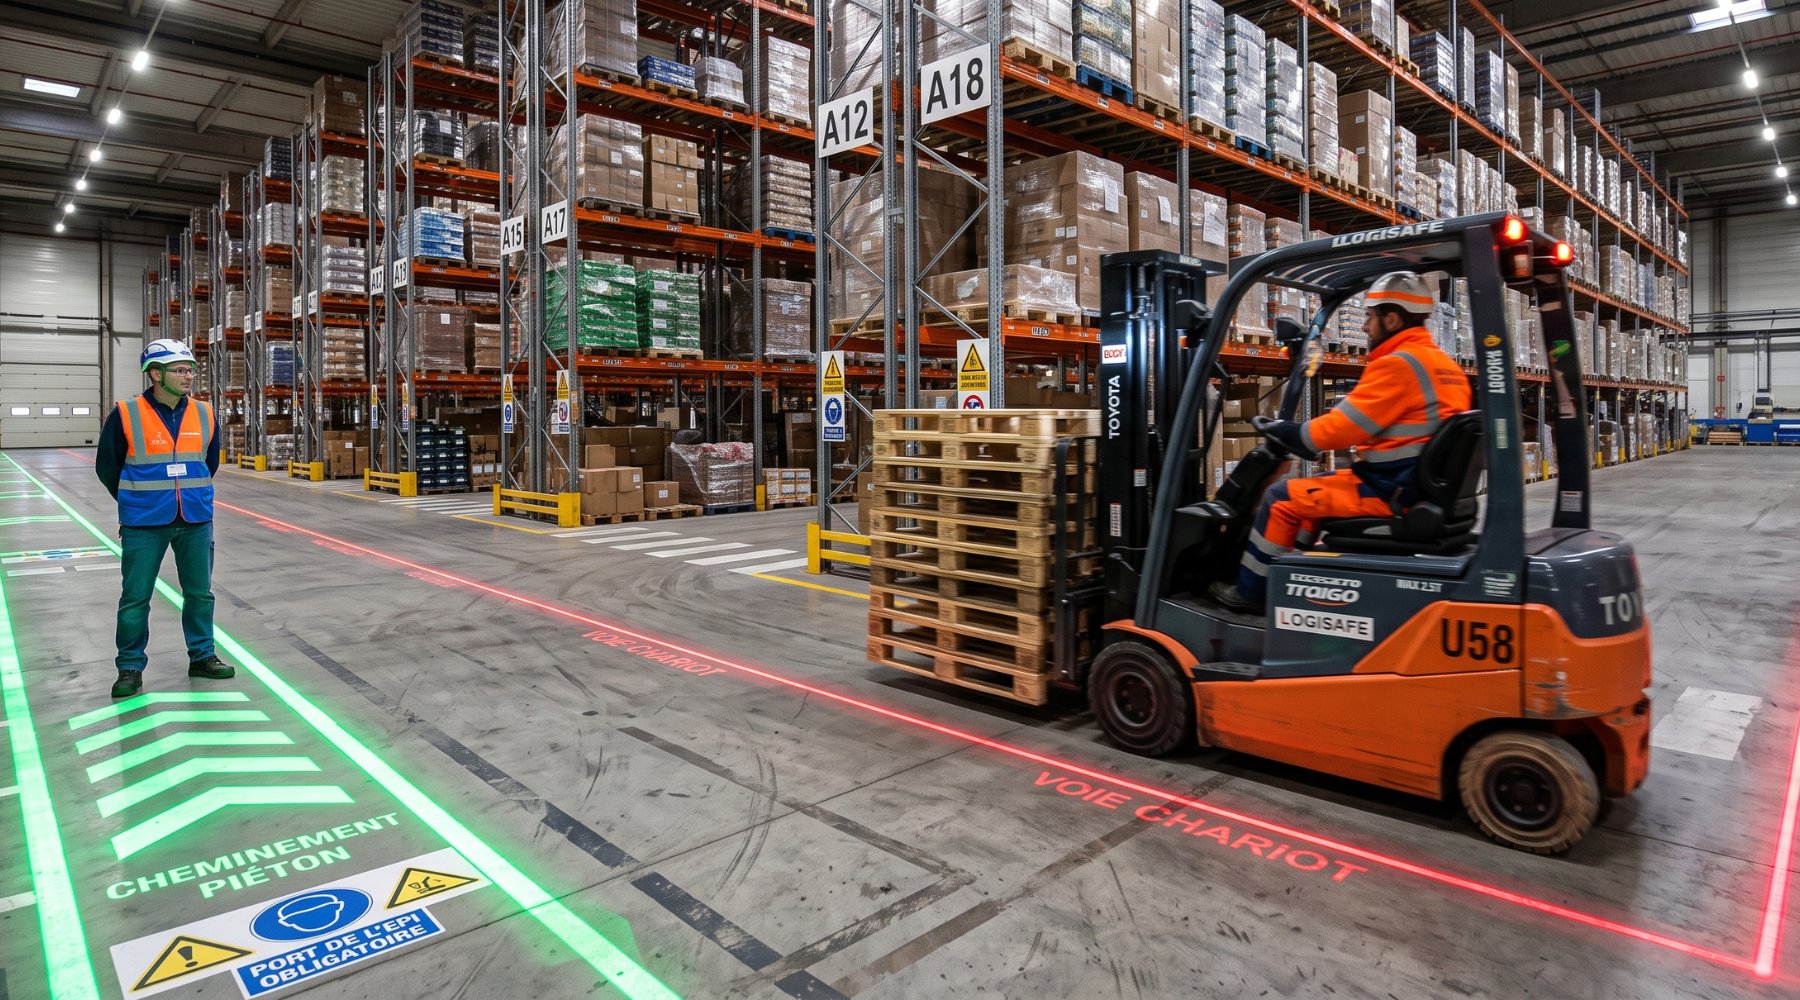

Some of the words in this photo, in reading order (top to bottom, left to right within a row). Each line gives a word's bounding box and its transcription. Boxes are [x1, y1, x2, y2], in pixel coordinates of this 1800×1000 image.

[926, 57, 984, 115] A18
[822, 99, 869, 150] A12
[502, 222, 522, 250] A15
[544, 207, 566, 238] A17
[394, 261, 407, 285] A13
[1108, 375, 1121, 439] TOYOTA
[1279, 609, 1369, 636] LOGISAFE
[1441, 617, 1515, 664] U58
[626, 645, 729, 677] CHARIOT
[1033, 771, 1132, 811] VOIE
[1135, 804, 1369, 883] CHARIOT
[105, 812, 402, 901] CHEMINEMENT
[200, 845, 352, 899] PIÉTON
[249, 942, 319, 978] PORT
[325, 930, 358, 954] DE
[363, 913, 420, 940] L'EPI
[259, 923, 428, 988] OBLIGATOIRE
